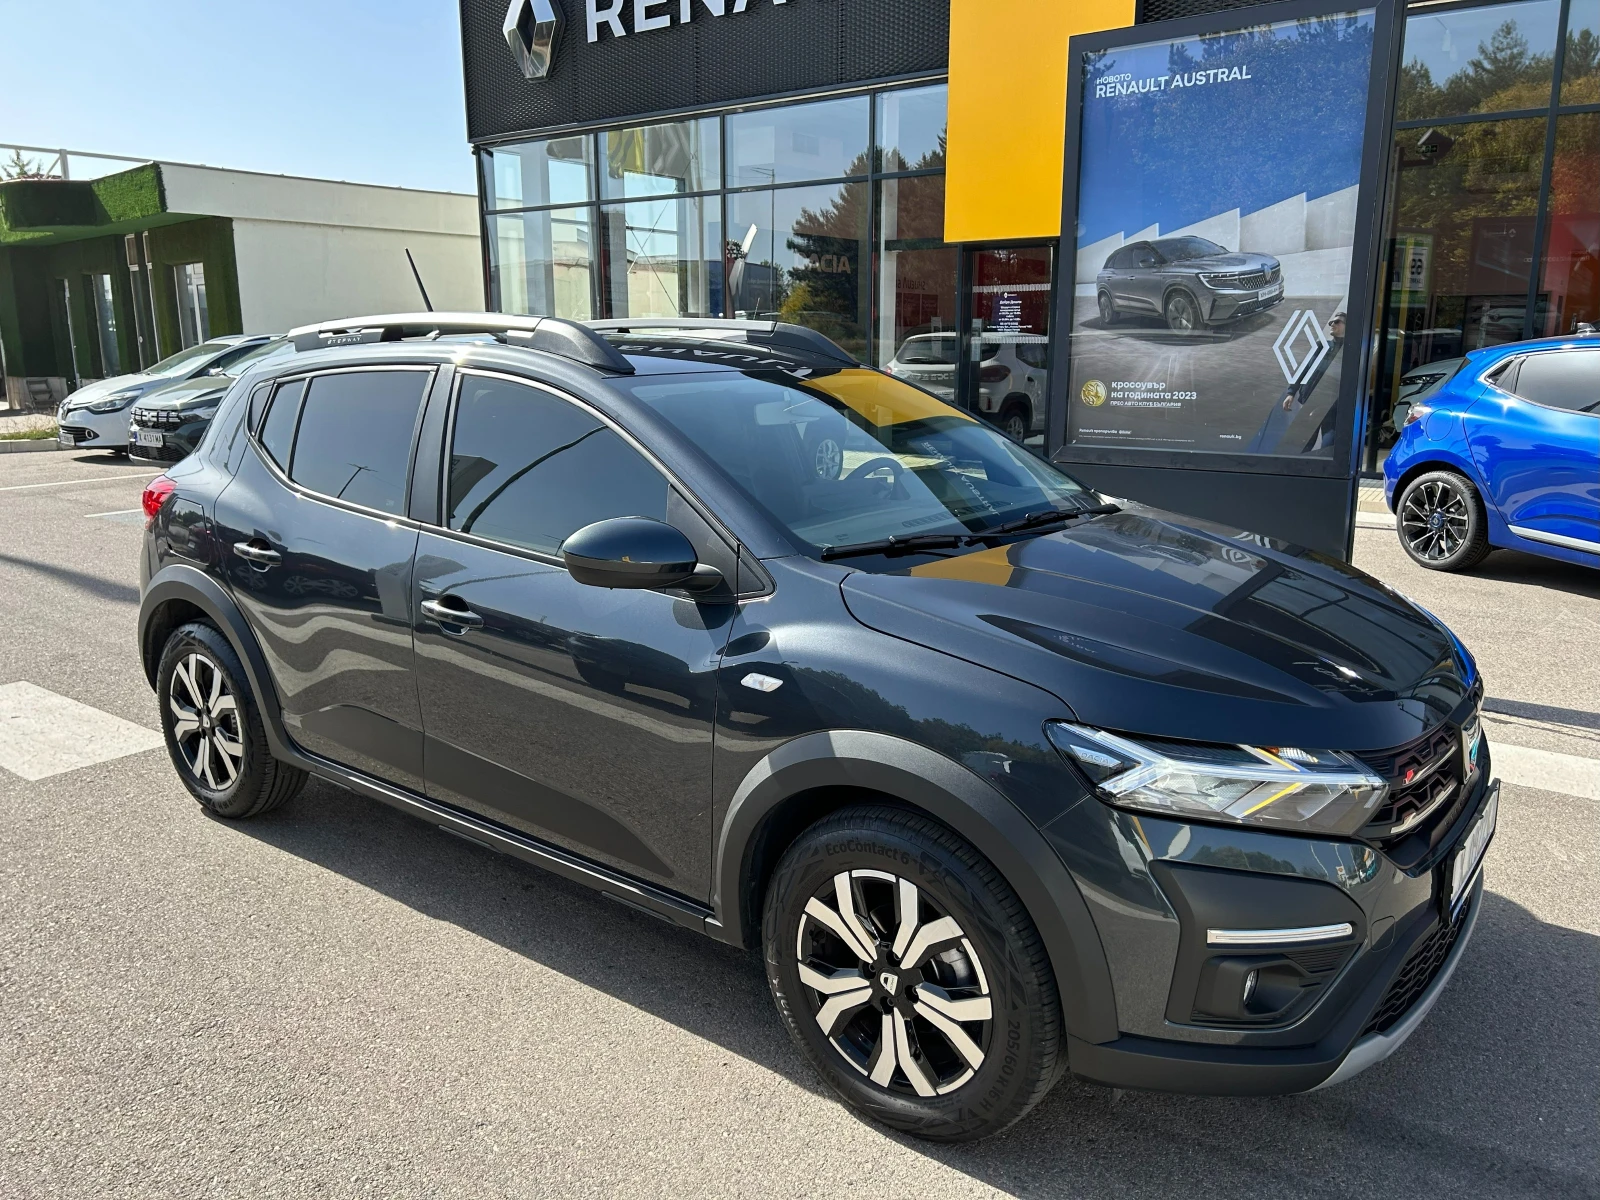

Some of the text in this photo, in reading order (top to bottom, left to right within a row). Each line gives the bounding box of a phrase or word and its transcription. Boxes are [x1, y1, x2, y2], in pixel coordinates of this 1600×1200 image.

[586, 0, 787, 43] REN
[1096, 73, 1132, 84] НОВОТО
[1096, 65, 1252, 98] RENAULT AUSTRAL
[795, 251, 851, 274] ACIA
[1111, 381, 1166, 390] кросоувър
[1124, 391, 1171, 400] годината
[1172, 391, 1197, 400] 2023
[1081, 752, 1109, 765] DACIA
[825, 840, 911, 865] EcoContact 6
[1001, 1020, 1020, 1076] 205/60
